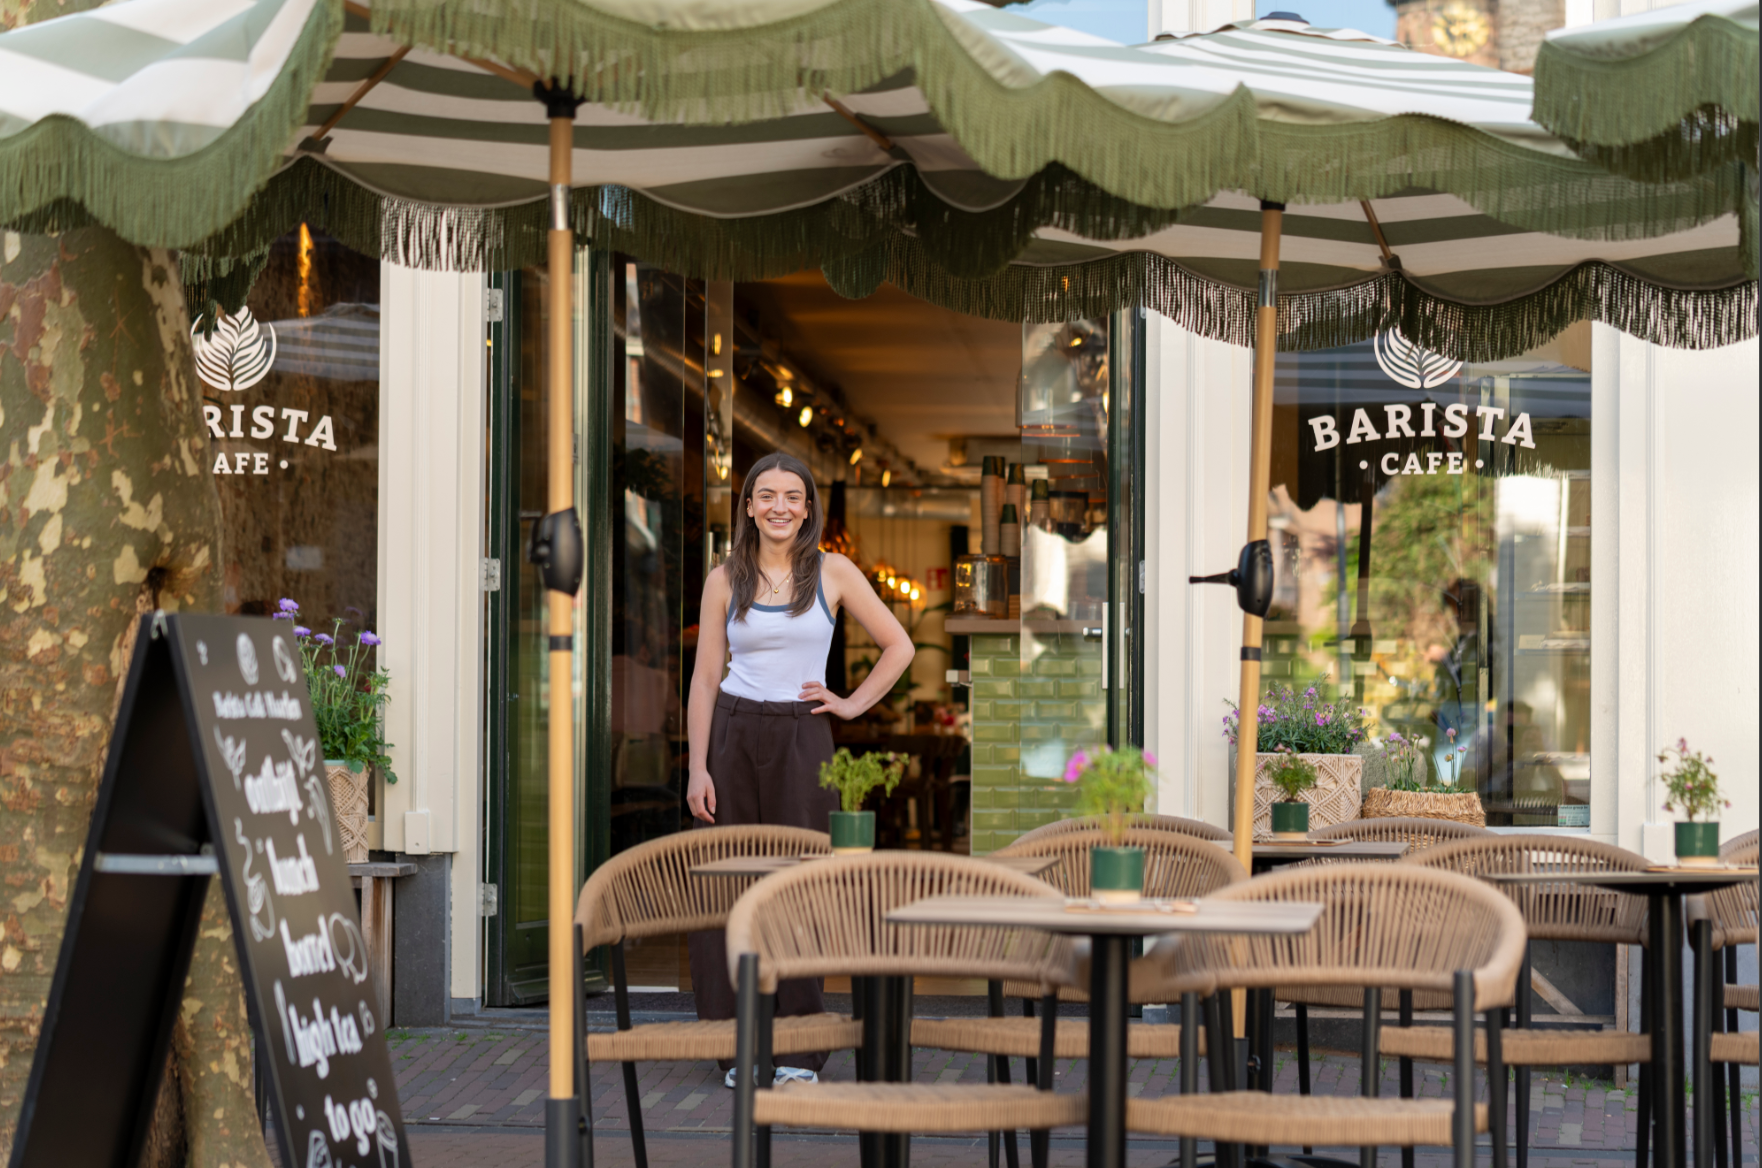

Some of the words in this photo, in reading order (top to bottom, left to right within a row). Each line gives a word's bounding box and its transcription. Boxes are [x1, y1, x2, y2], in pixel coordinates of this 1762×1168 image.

[202, 404, 338, 452] RISTA
[1307, 402, 1536, 452] BARISTA
[212, 452, 269, 475] AFE
[1380, 452, 1463, 476] CAFE
[288, 997, 336, 1080] high
[330, 1005, 363, 1055] tea
[324, 1093, 350, 1143] to
[349, 1097, 377, 1156] go
